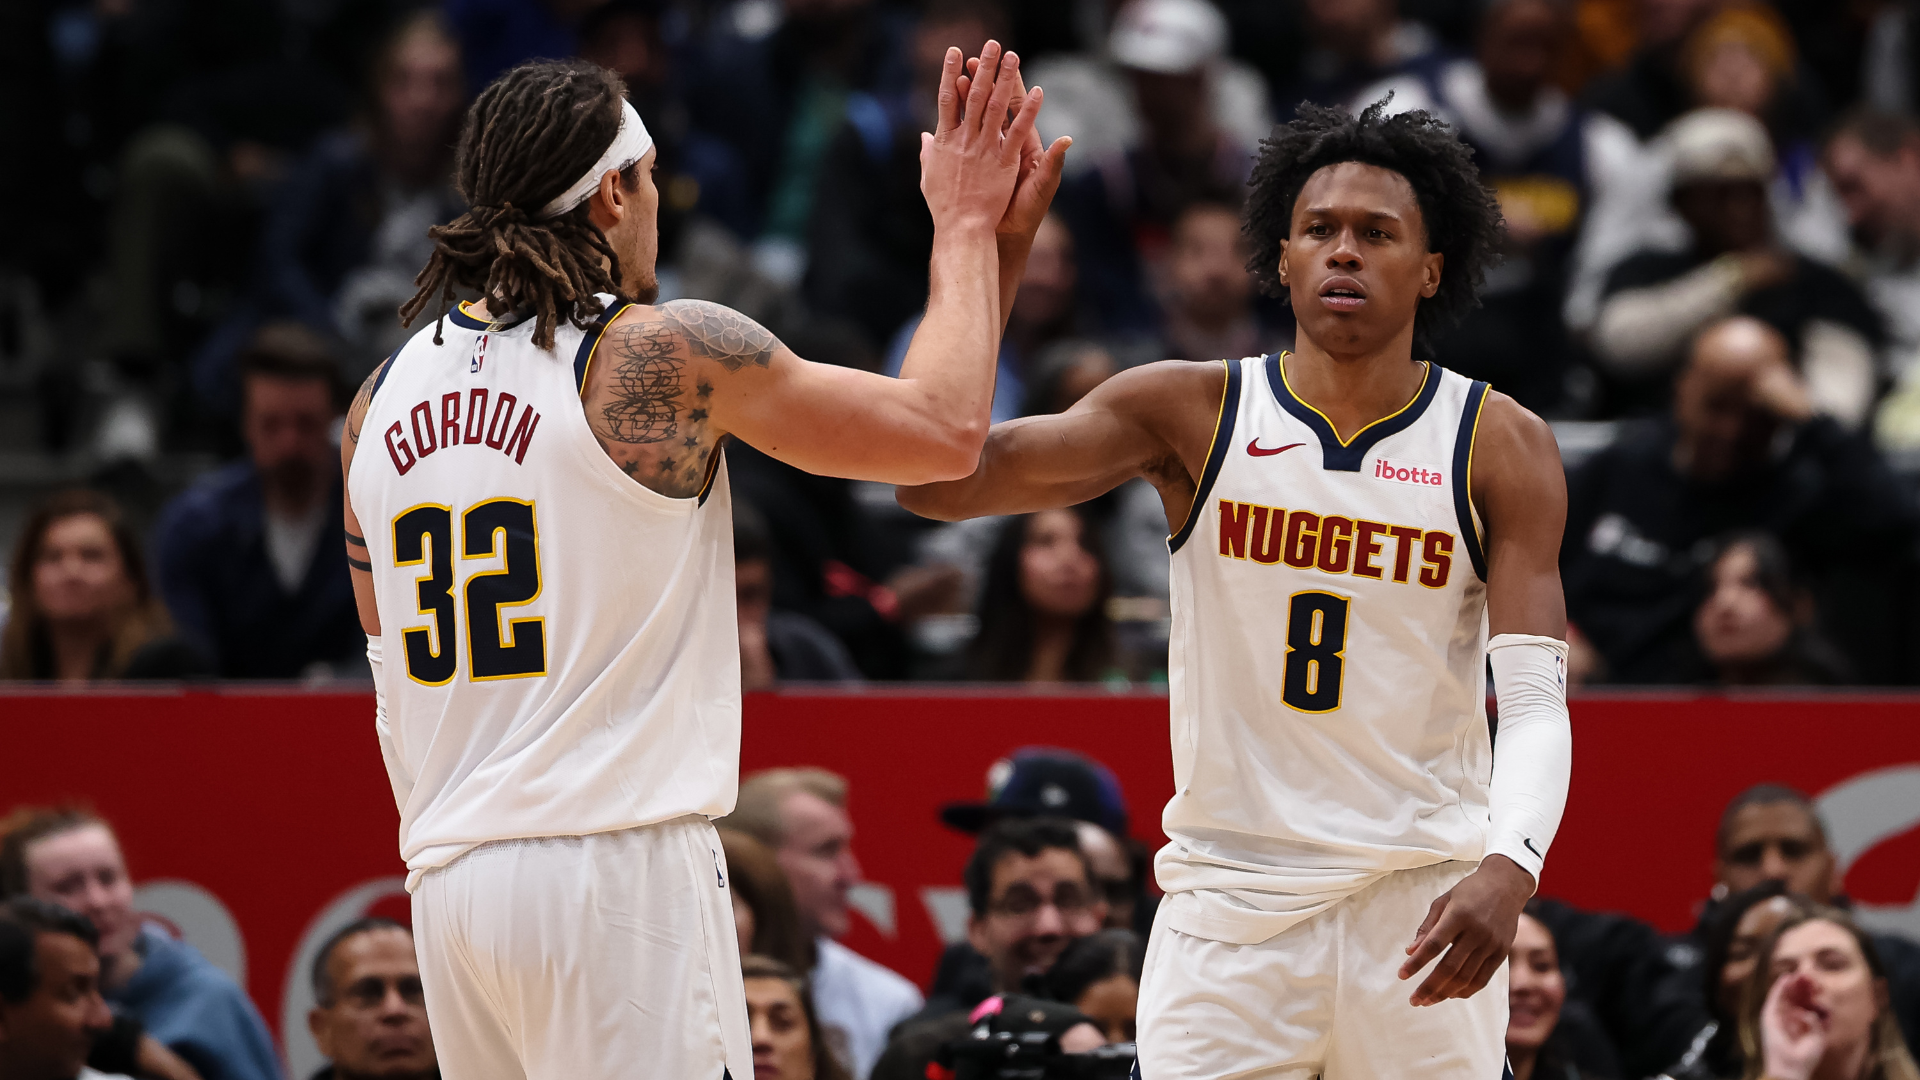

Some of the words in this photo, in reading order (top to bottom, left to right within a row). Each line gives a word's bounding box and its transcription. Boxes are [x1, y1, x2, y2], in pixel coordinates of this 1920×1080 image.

[384, 388, 541, 476] GORDON
[1375, 459, 1442, 486] ibotta
[1218, 498, 1456, 589] NUGGETS
[391, 496, 547, 687] 32
[1280, 589, 1351, 714] 8
